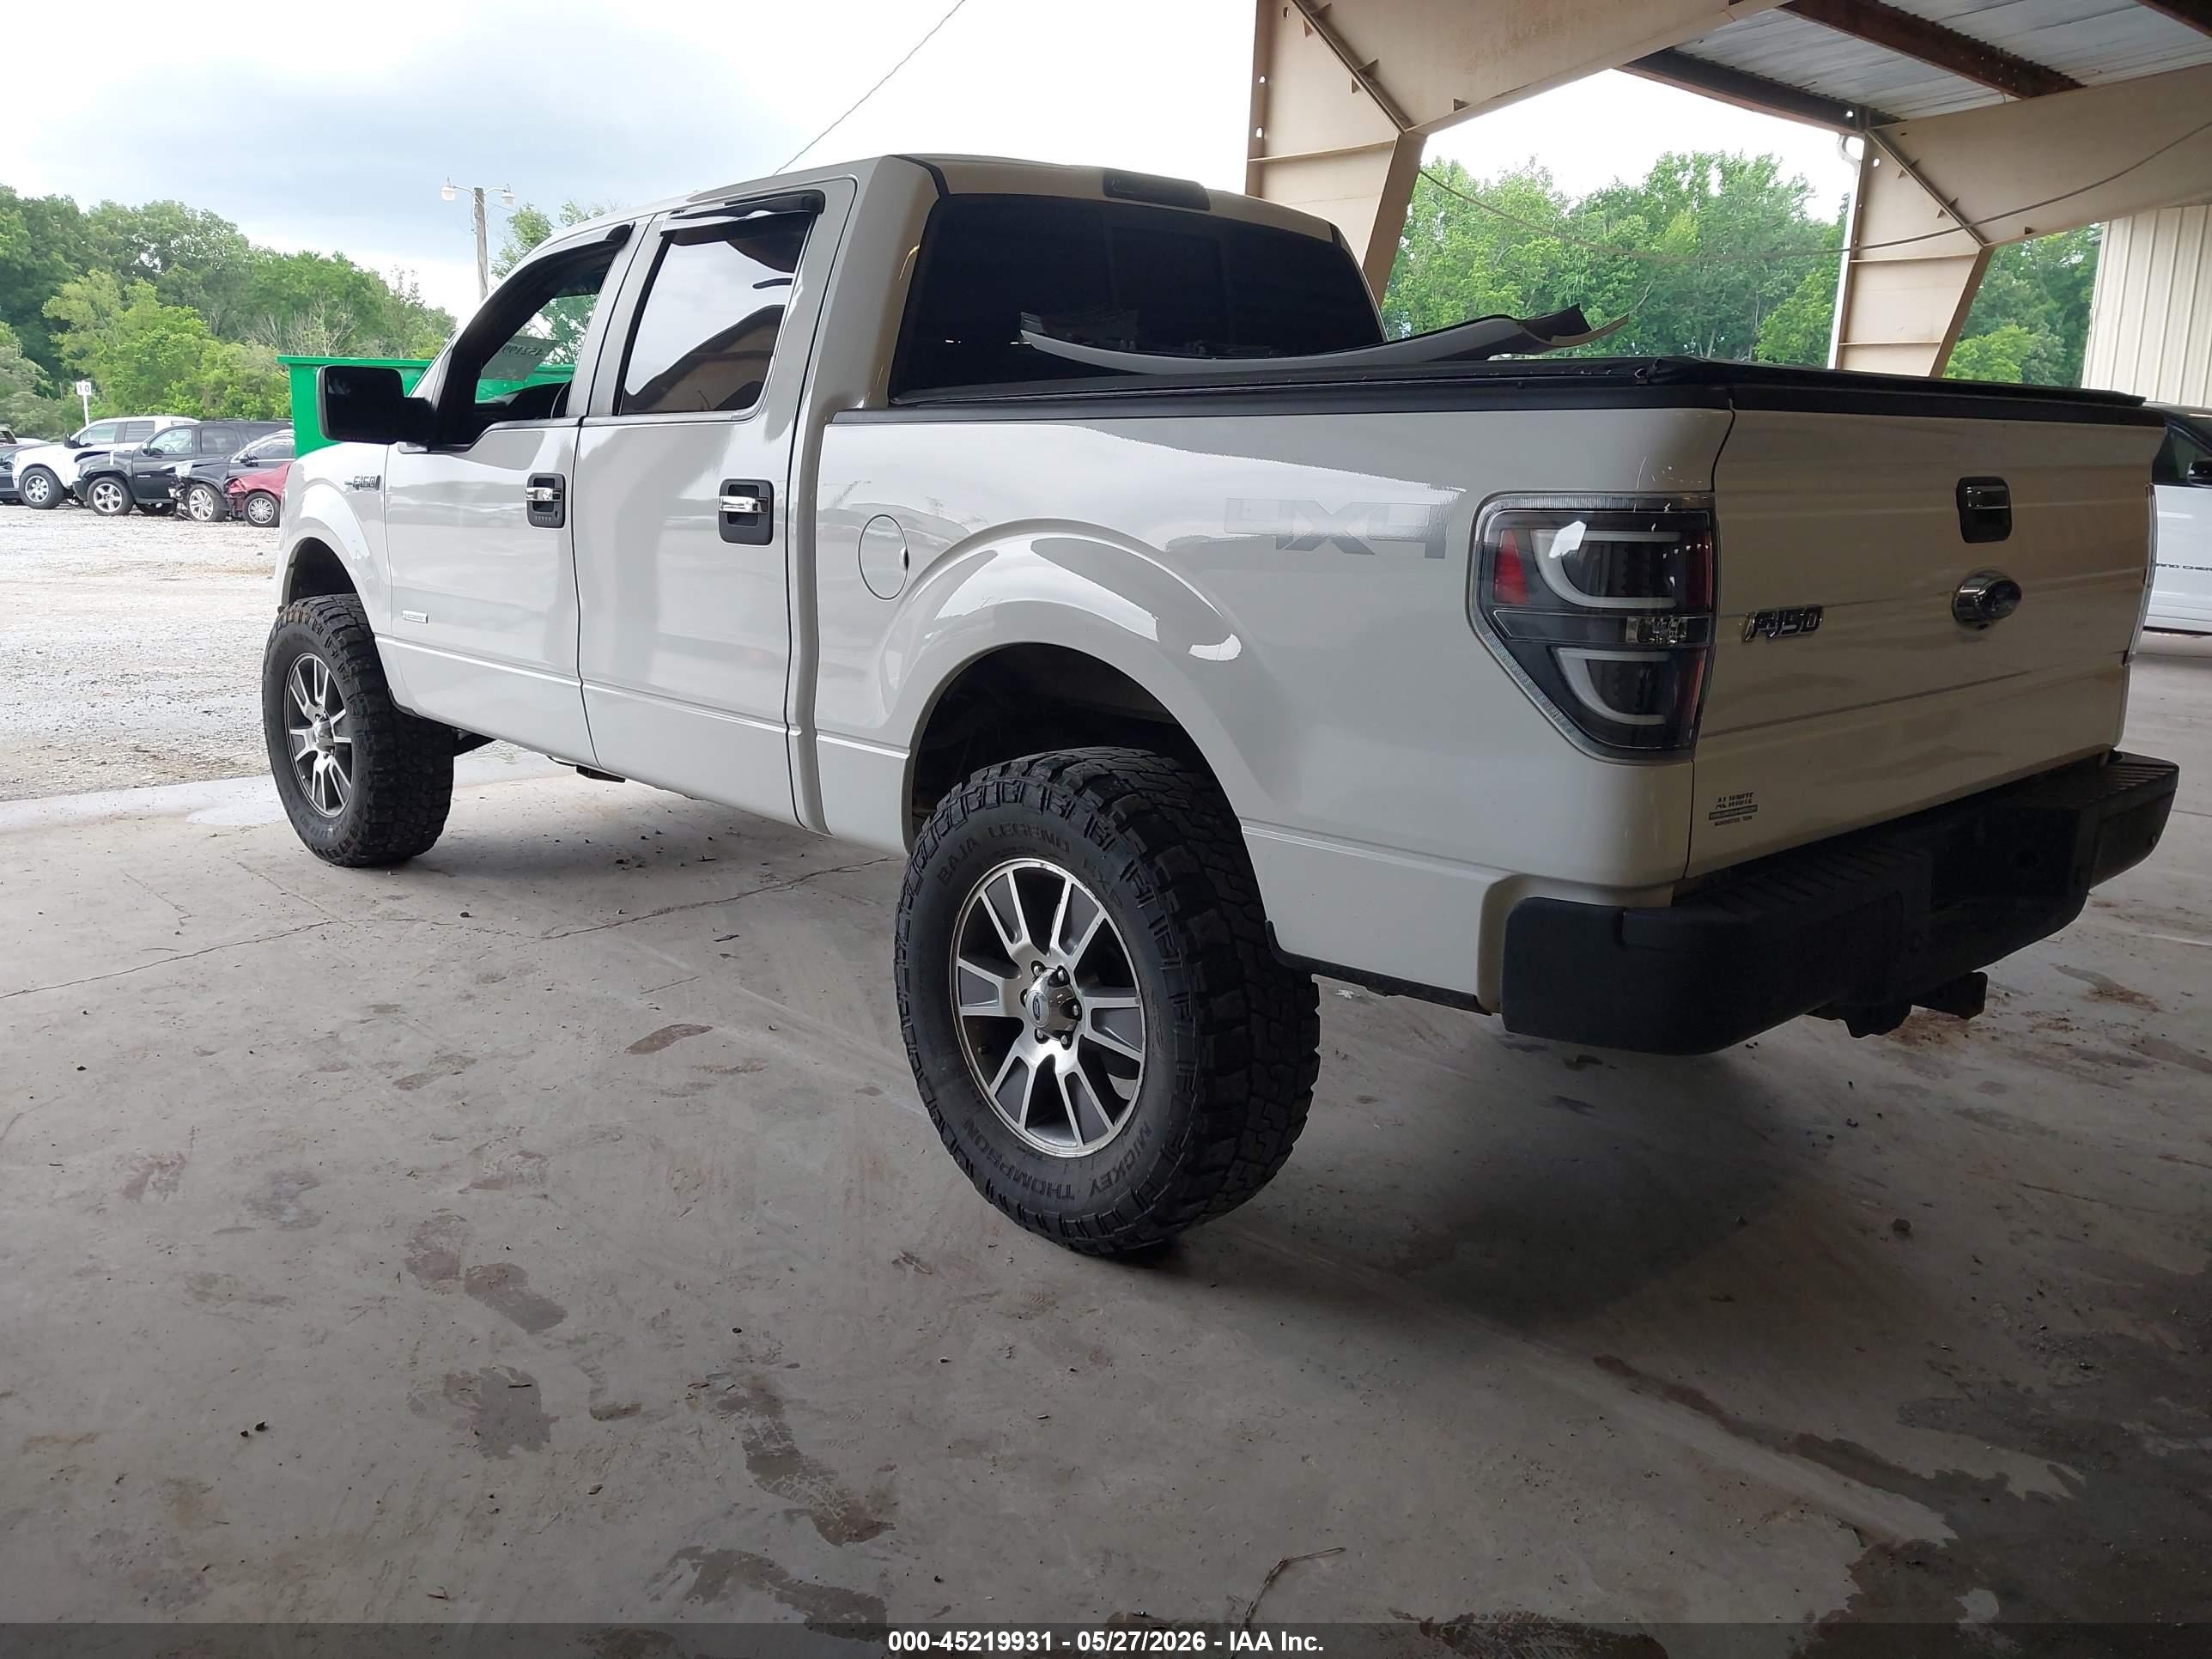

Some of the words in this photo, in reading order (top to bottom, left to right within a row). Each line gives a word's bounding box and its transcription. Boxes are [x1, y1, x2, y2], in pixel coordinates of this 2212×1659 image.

[937, 836, 977, 886] BAJA
[988, 823, 1071, 854] LEGEND
[962, 1117, 1075, 1200] THOMPSON
[1089, 1120, 1152, 1198] MICKEY
